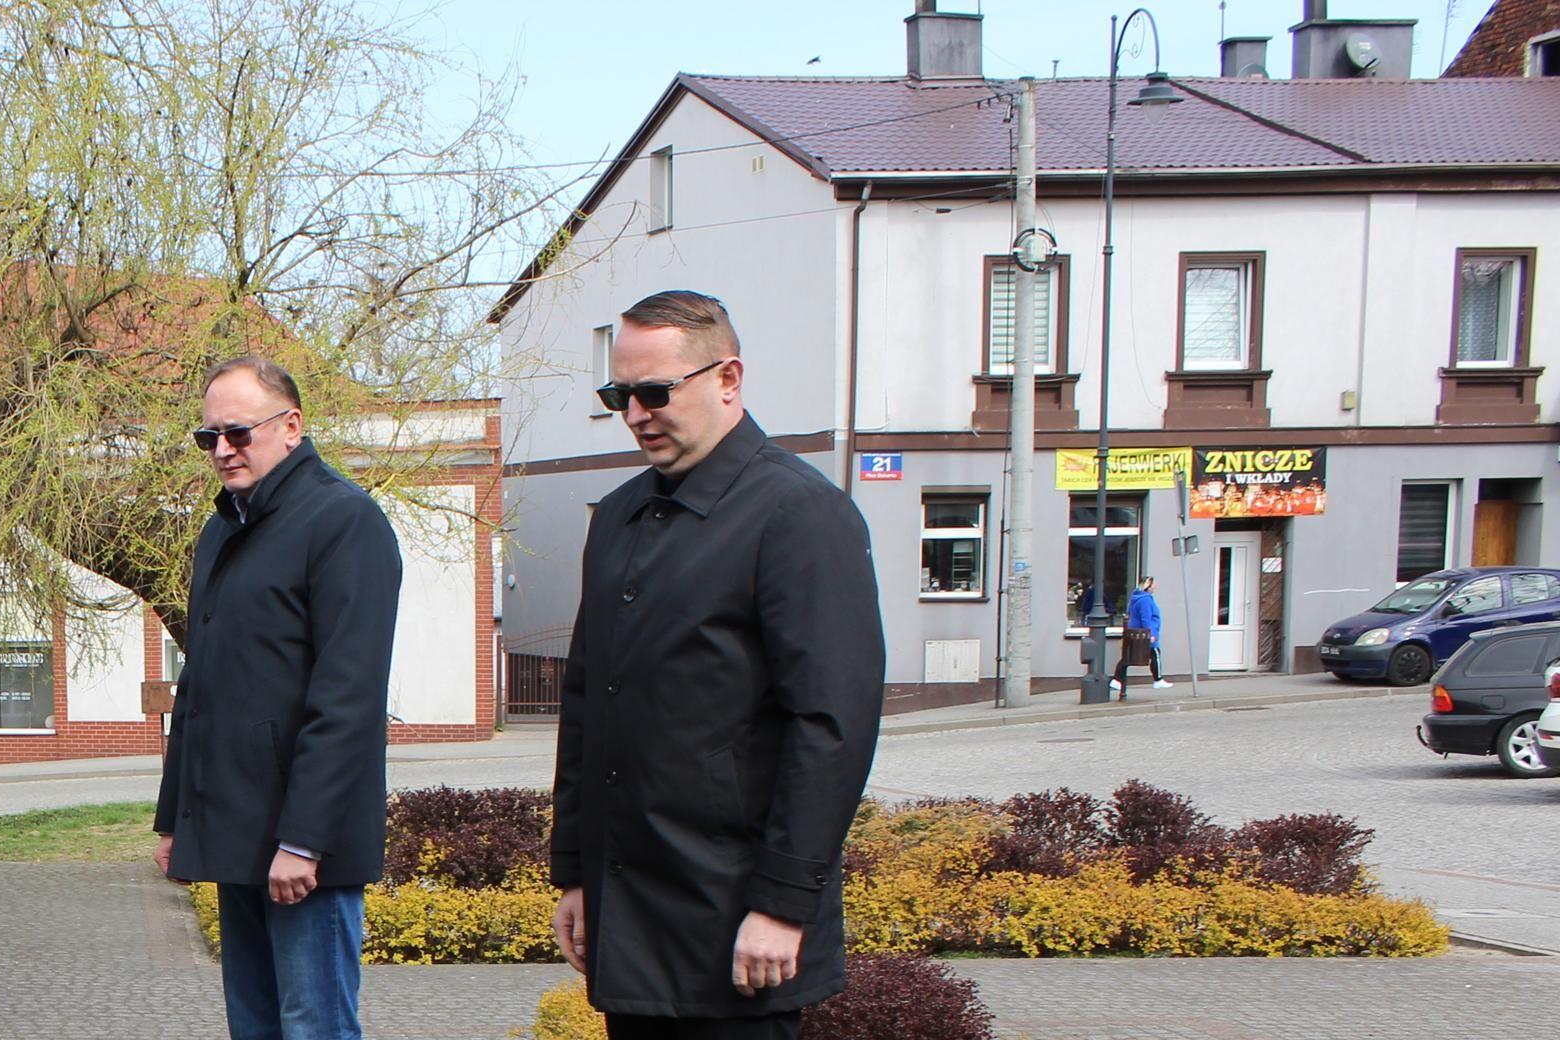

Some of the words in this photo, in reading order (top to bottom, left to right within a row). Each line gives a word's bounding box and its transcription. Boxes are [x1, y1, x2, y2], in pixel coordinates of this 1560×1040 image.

[872, 456, 891, 472] 21
[1205, 449, 1313, 473] ZNICZE
[1225, 473, 1232, 485] I
[1235, 472, 1293, 484] WKŁADY
